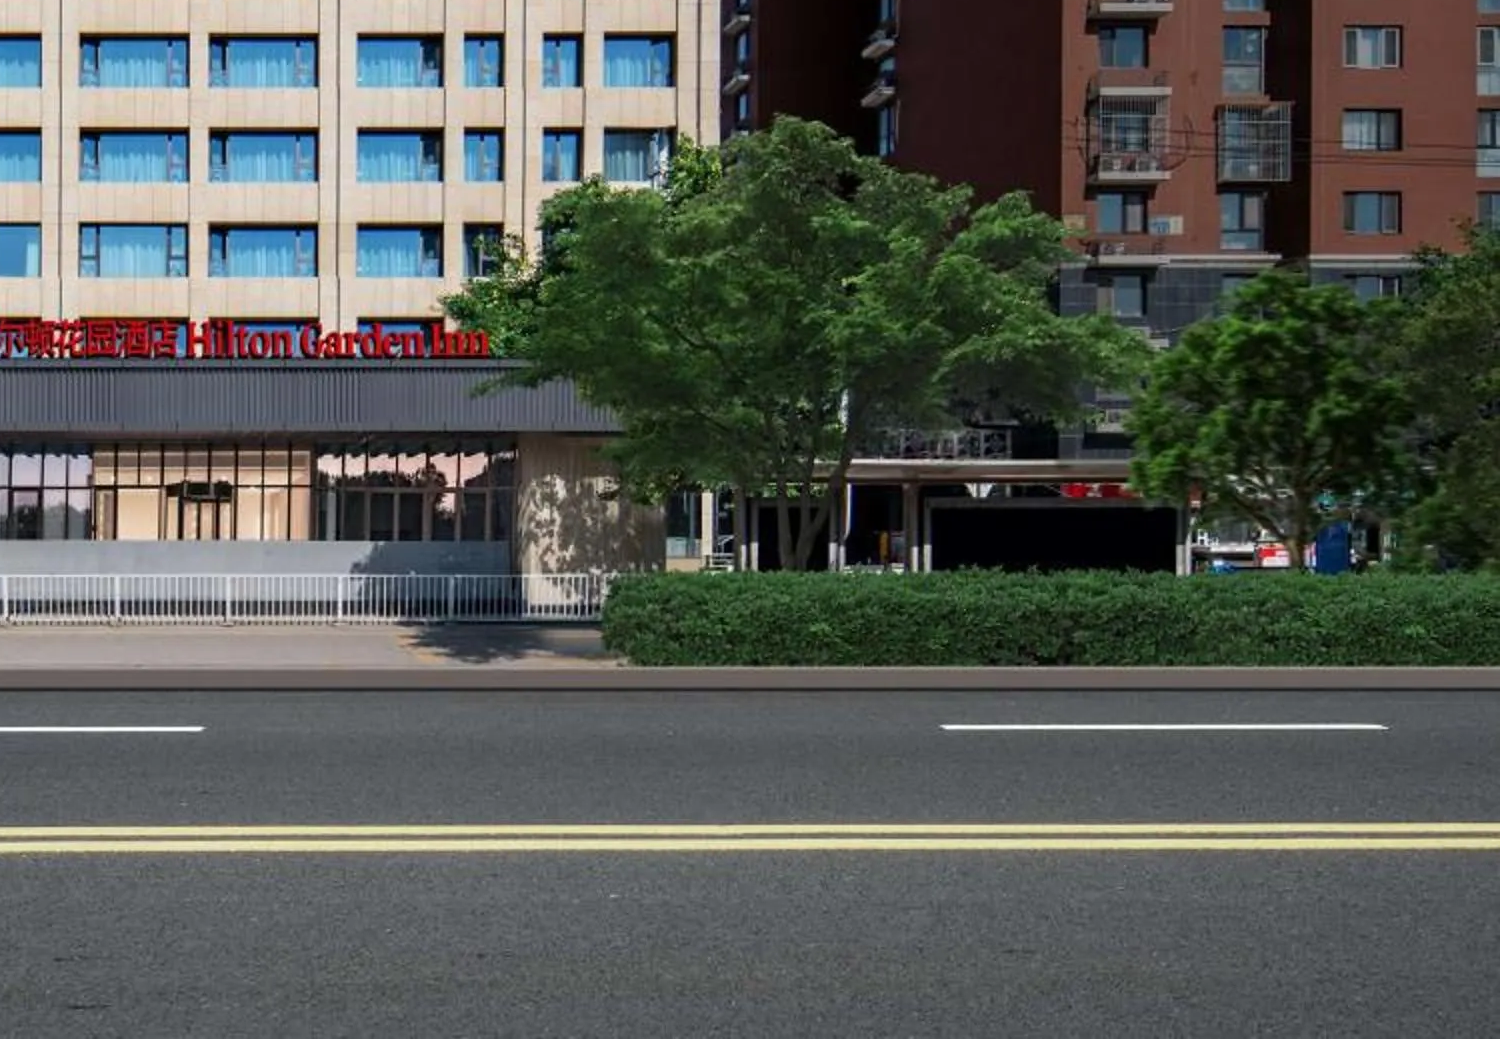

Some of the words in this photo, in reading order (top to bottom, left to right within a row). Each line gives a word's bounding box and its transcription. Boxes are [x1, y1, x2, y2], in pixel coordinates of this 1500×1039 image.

[186, 319, 293, 358] Hilton
[300, 321, 423, 359] Garden
[430, 322, 489, 359] Inn
